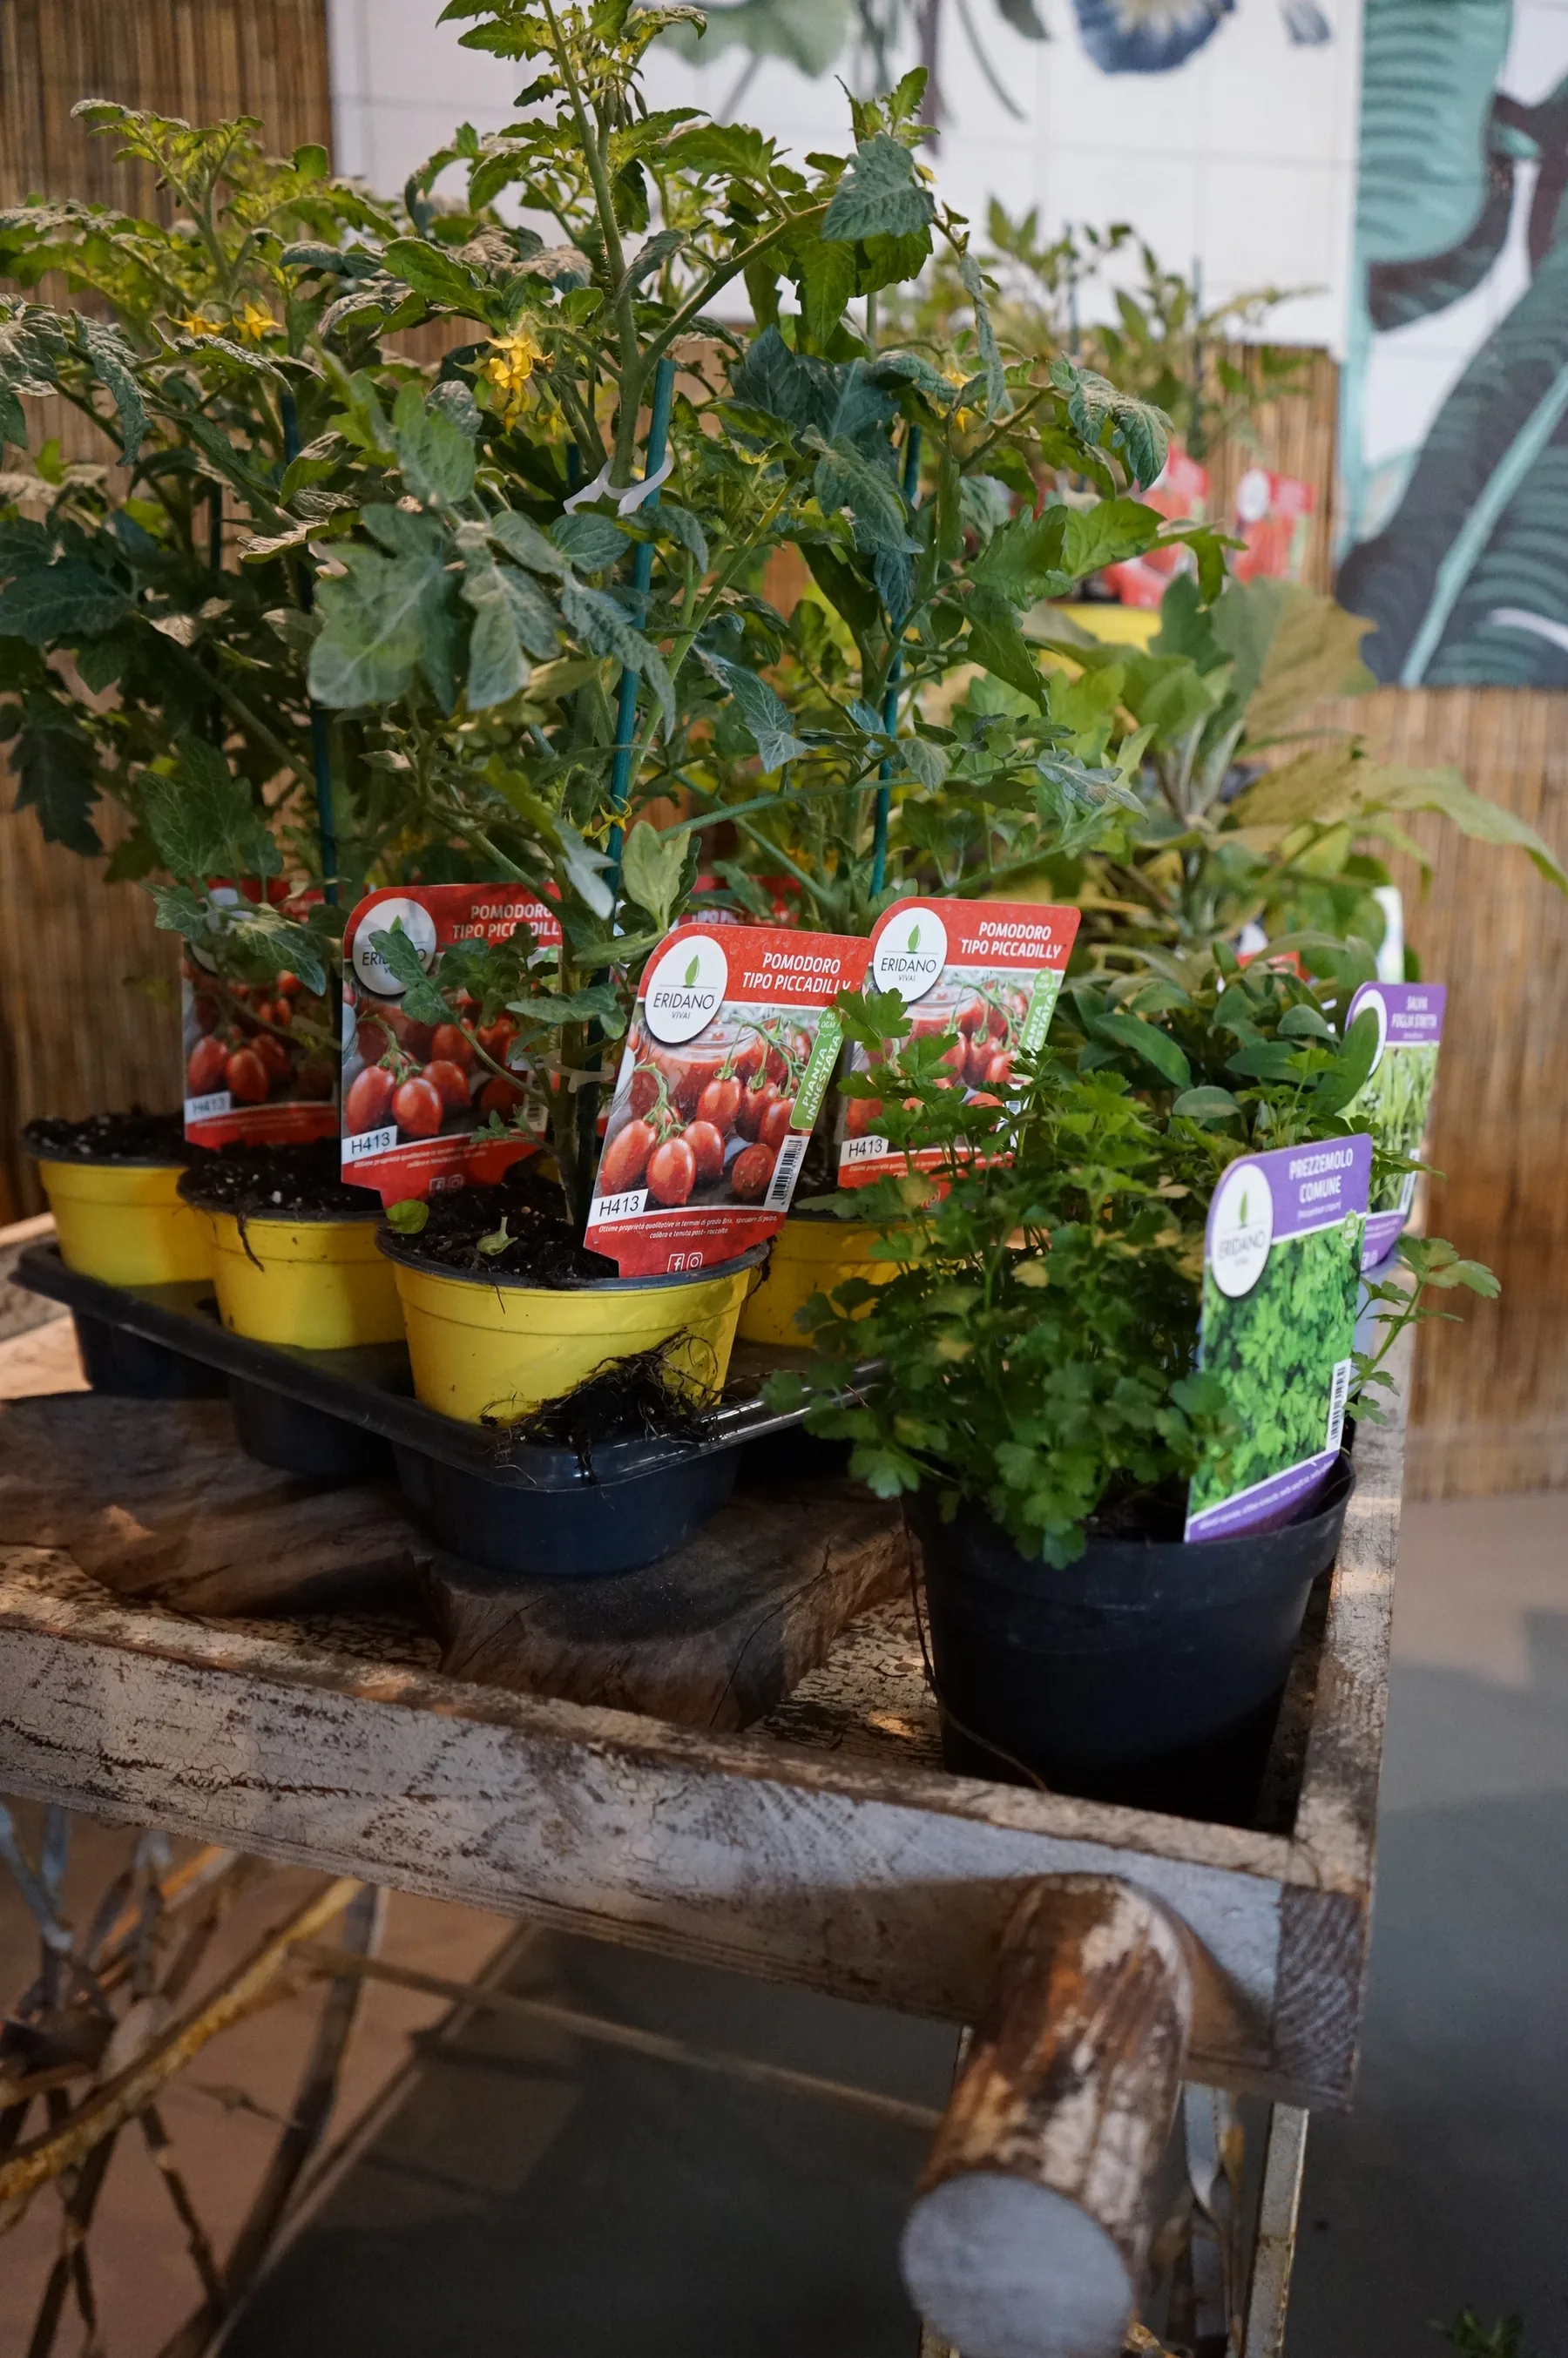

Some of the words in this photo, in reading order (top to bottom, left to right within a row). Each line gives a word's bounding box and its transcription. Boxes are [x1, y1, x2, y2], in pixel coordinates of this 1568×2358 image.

[470, 903, 552, 920] POMODORO
[452, 923, 484, 939] TIPO
[488, 922, 559, 937] PICCDILL
[978, 922, 1051, 941] POMODORO
[961, 939, 989, 955] TIPO
[990, 941, 1062, 959] PICCADILLY
[761, 952, 841, 975] POMODORO
[881, 957, 936, 974] ERIDANO
[742, 971, 773, 990] TIPO
[774, 974, 851, 994] PICCADILLY
[653, 992, 714, 1010] ERIDANO
[672, 1011, 690, 1020] VIVAI
[801, 1048, 828, 1107] PIANTA
[806, 1036, 841, 1121] INNESTATA
[351, 1132, 390, 1154] H413
[848, 1138, 882, 1159] H413
[1288, 1147, 1354, 1181] PREZZEMOLO
[1299, 1175, 1342, 1204] COMUNE
[599, 1195, 639, 1217] H413
